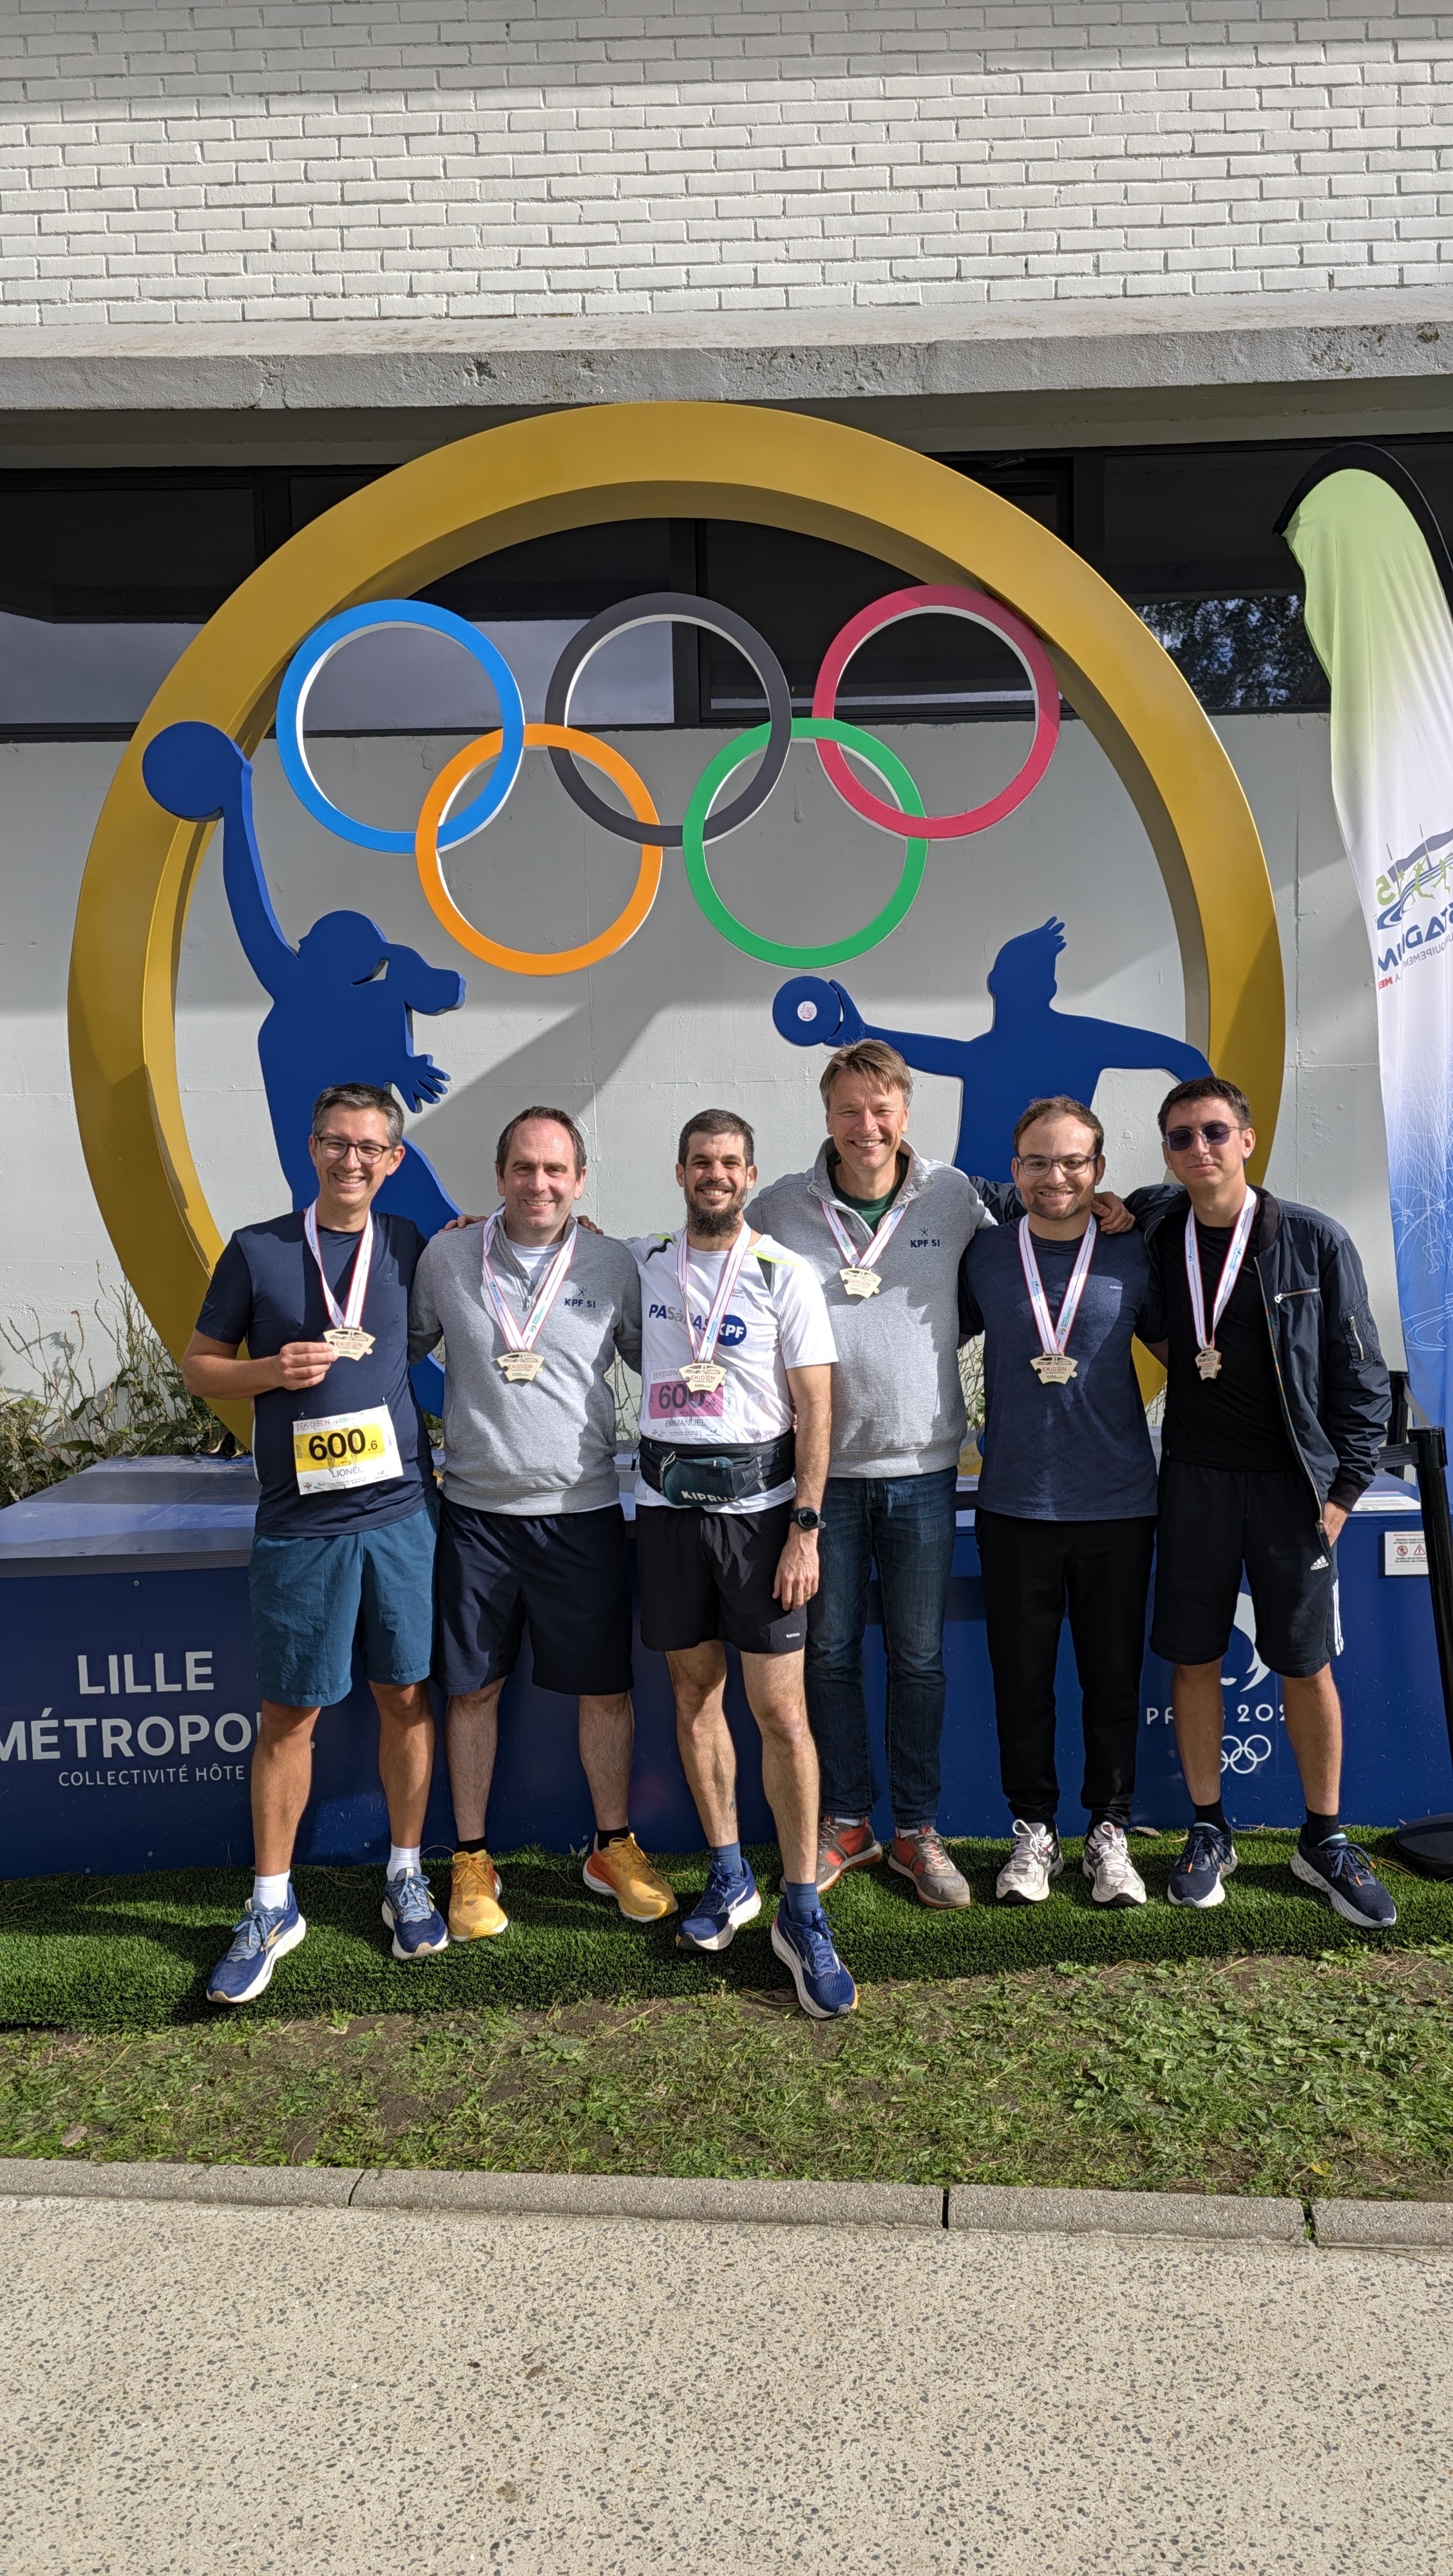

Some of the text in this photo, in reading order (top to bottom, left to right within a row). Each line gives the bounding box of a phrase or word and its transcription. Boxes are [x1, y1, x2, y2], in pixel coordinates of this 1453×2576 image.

[910, 1239, 929, 1248] KPF
[564, 1298, 584, 1307] KPF
[300, 1419, 330, 1429] EKIDEN
[665, 1419, 706, 1428] EMMANUEL
[331, 1466, 363, 1478] LIONEL
[77, 1651, 214, 1694] LILLE
[1237, 1703, 1286, 1723] 20
[0, 1707, 263, 1761] MÉTROPO
[59, 1763, 245, 1786] COLLECTIVITÉ HÔTE
